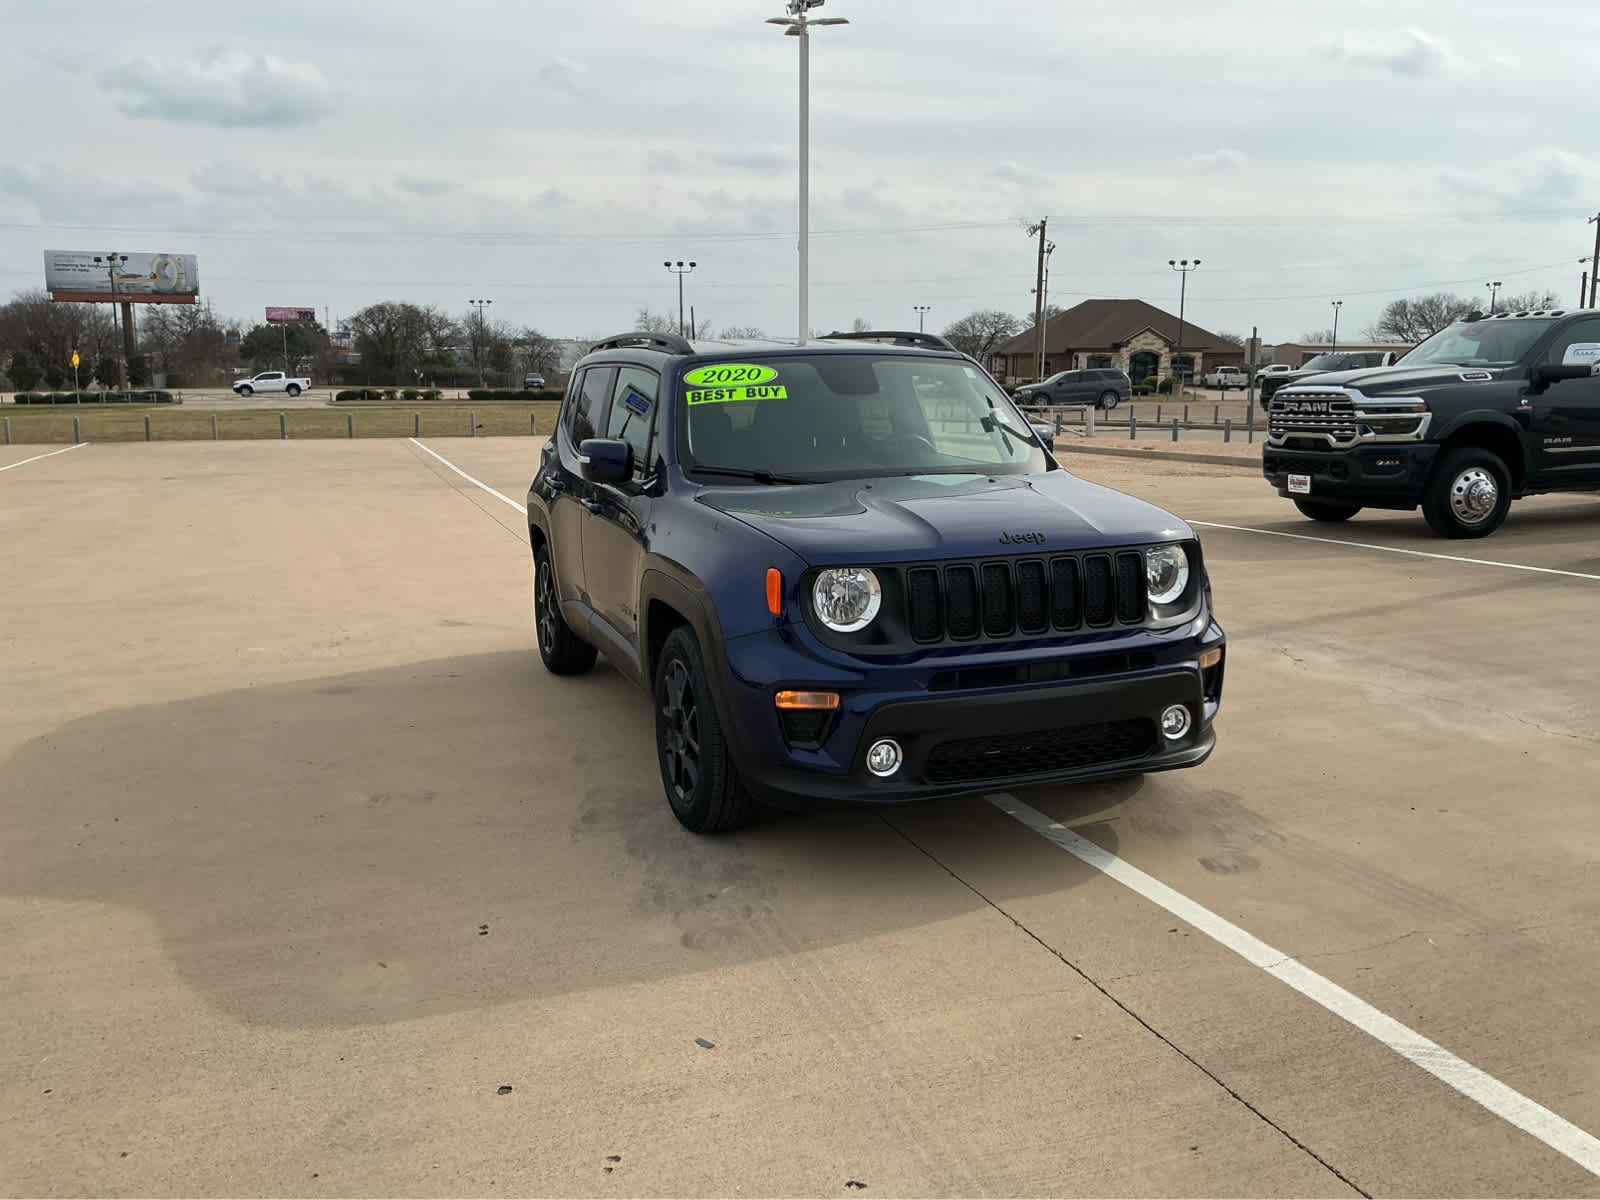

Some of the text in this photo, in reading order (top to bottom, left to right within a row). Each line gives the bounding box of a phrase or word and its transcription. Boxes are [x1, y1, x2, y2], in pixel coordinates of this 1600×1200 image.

[702, 367, 762, 384] 2020
[690, 386, 780, 403] BEST BUY
[1284, 402, 1328, 412] RAM
[999, 530, 1047, 545] Jeep
